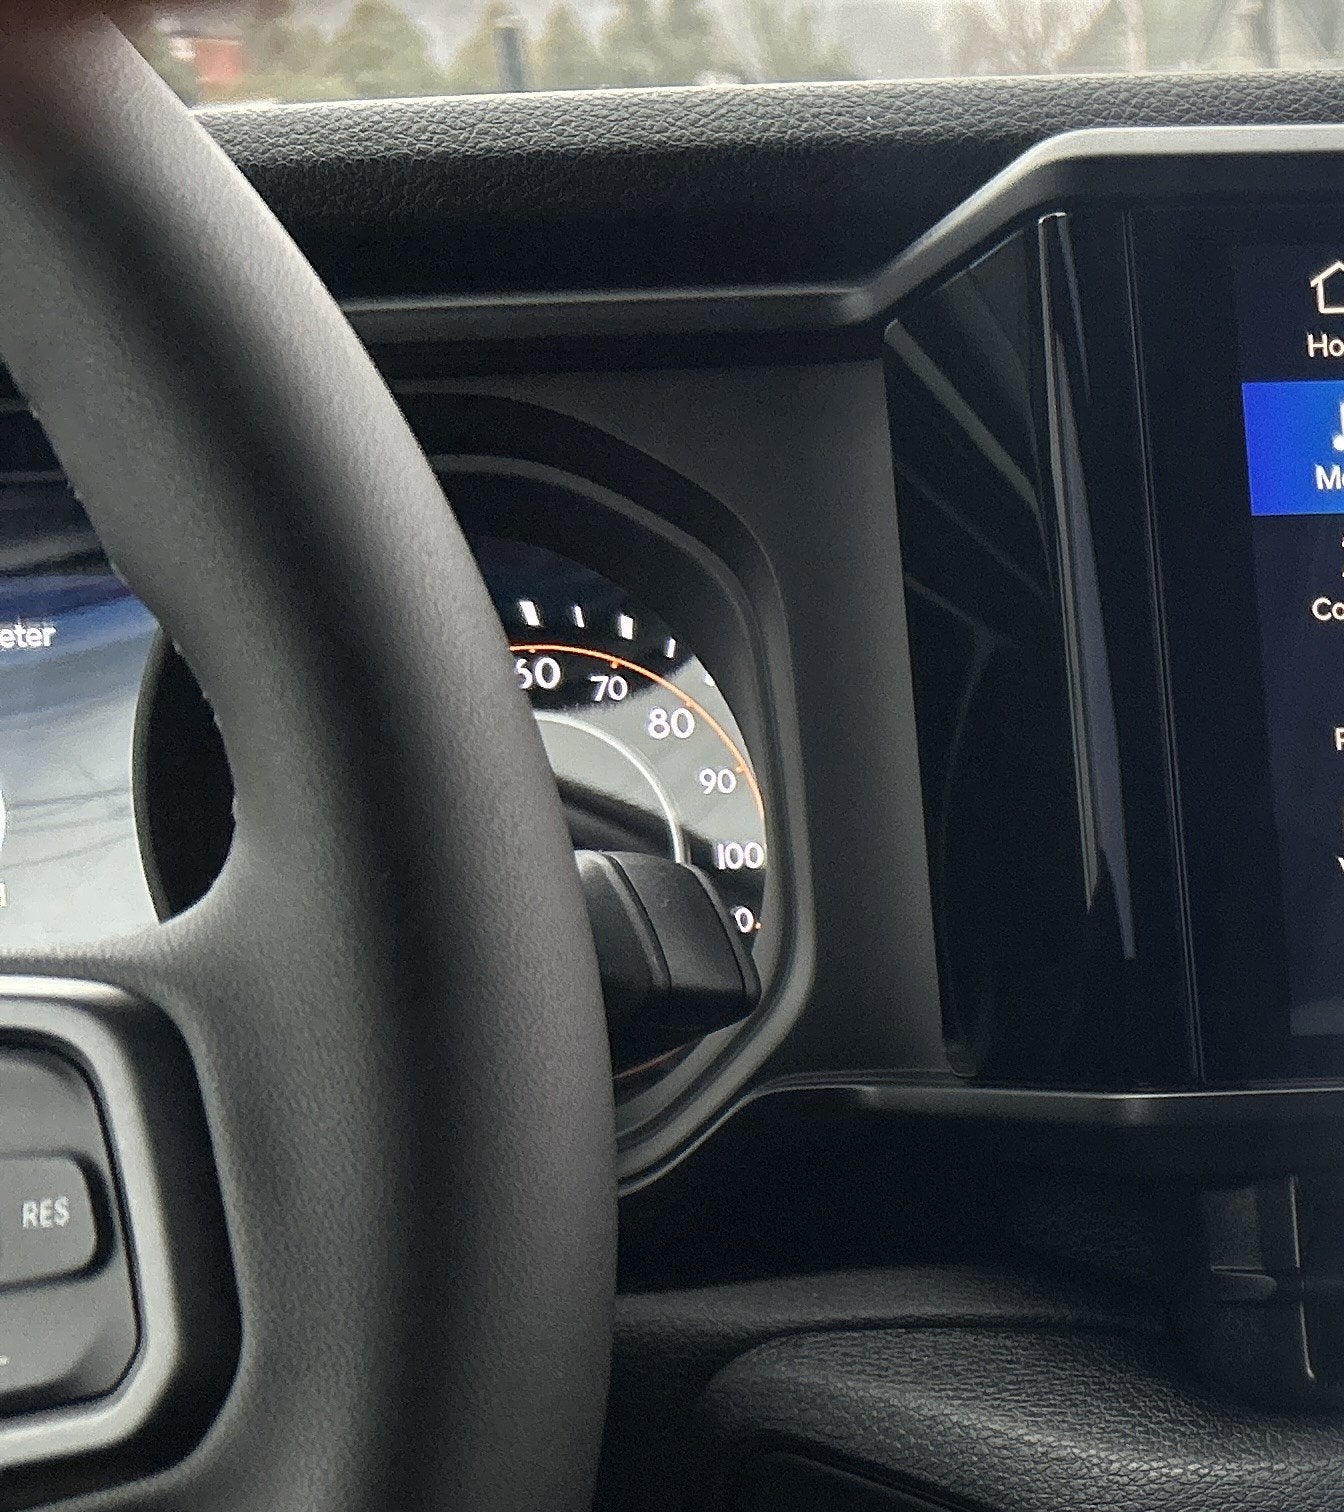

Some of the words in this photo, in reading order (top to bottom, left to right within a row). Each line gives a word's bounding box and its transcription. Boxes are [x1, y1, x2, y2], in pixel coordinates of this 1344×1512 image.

[589, 674, 630, 702] 70
[646, 704, 698, 740] 80
[698, 766, 738, 795] 90
[715, 840, 766, 871] 100
[22, 1196, 70, 1228] RES
